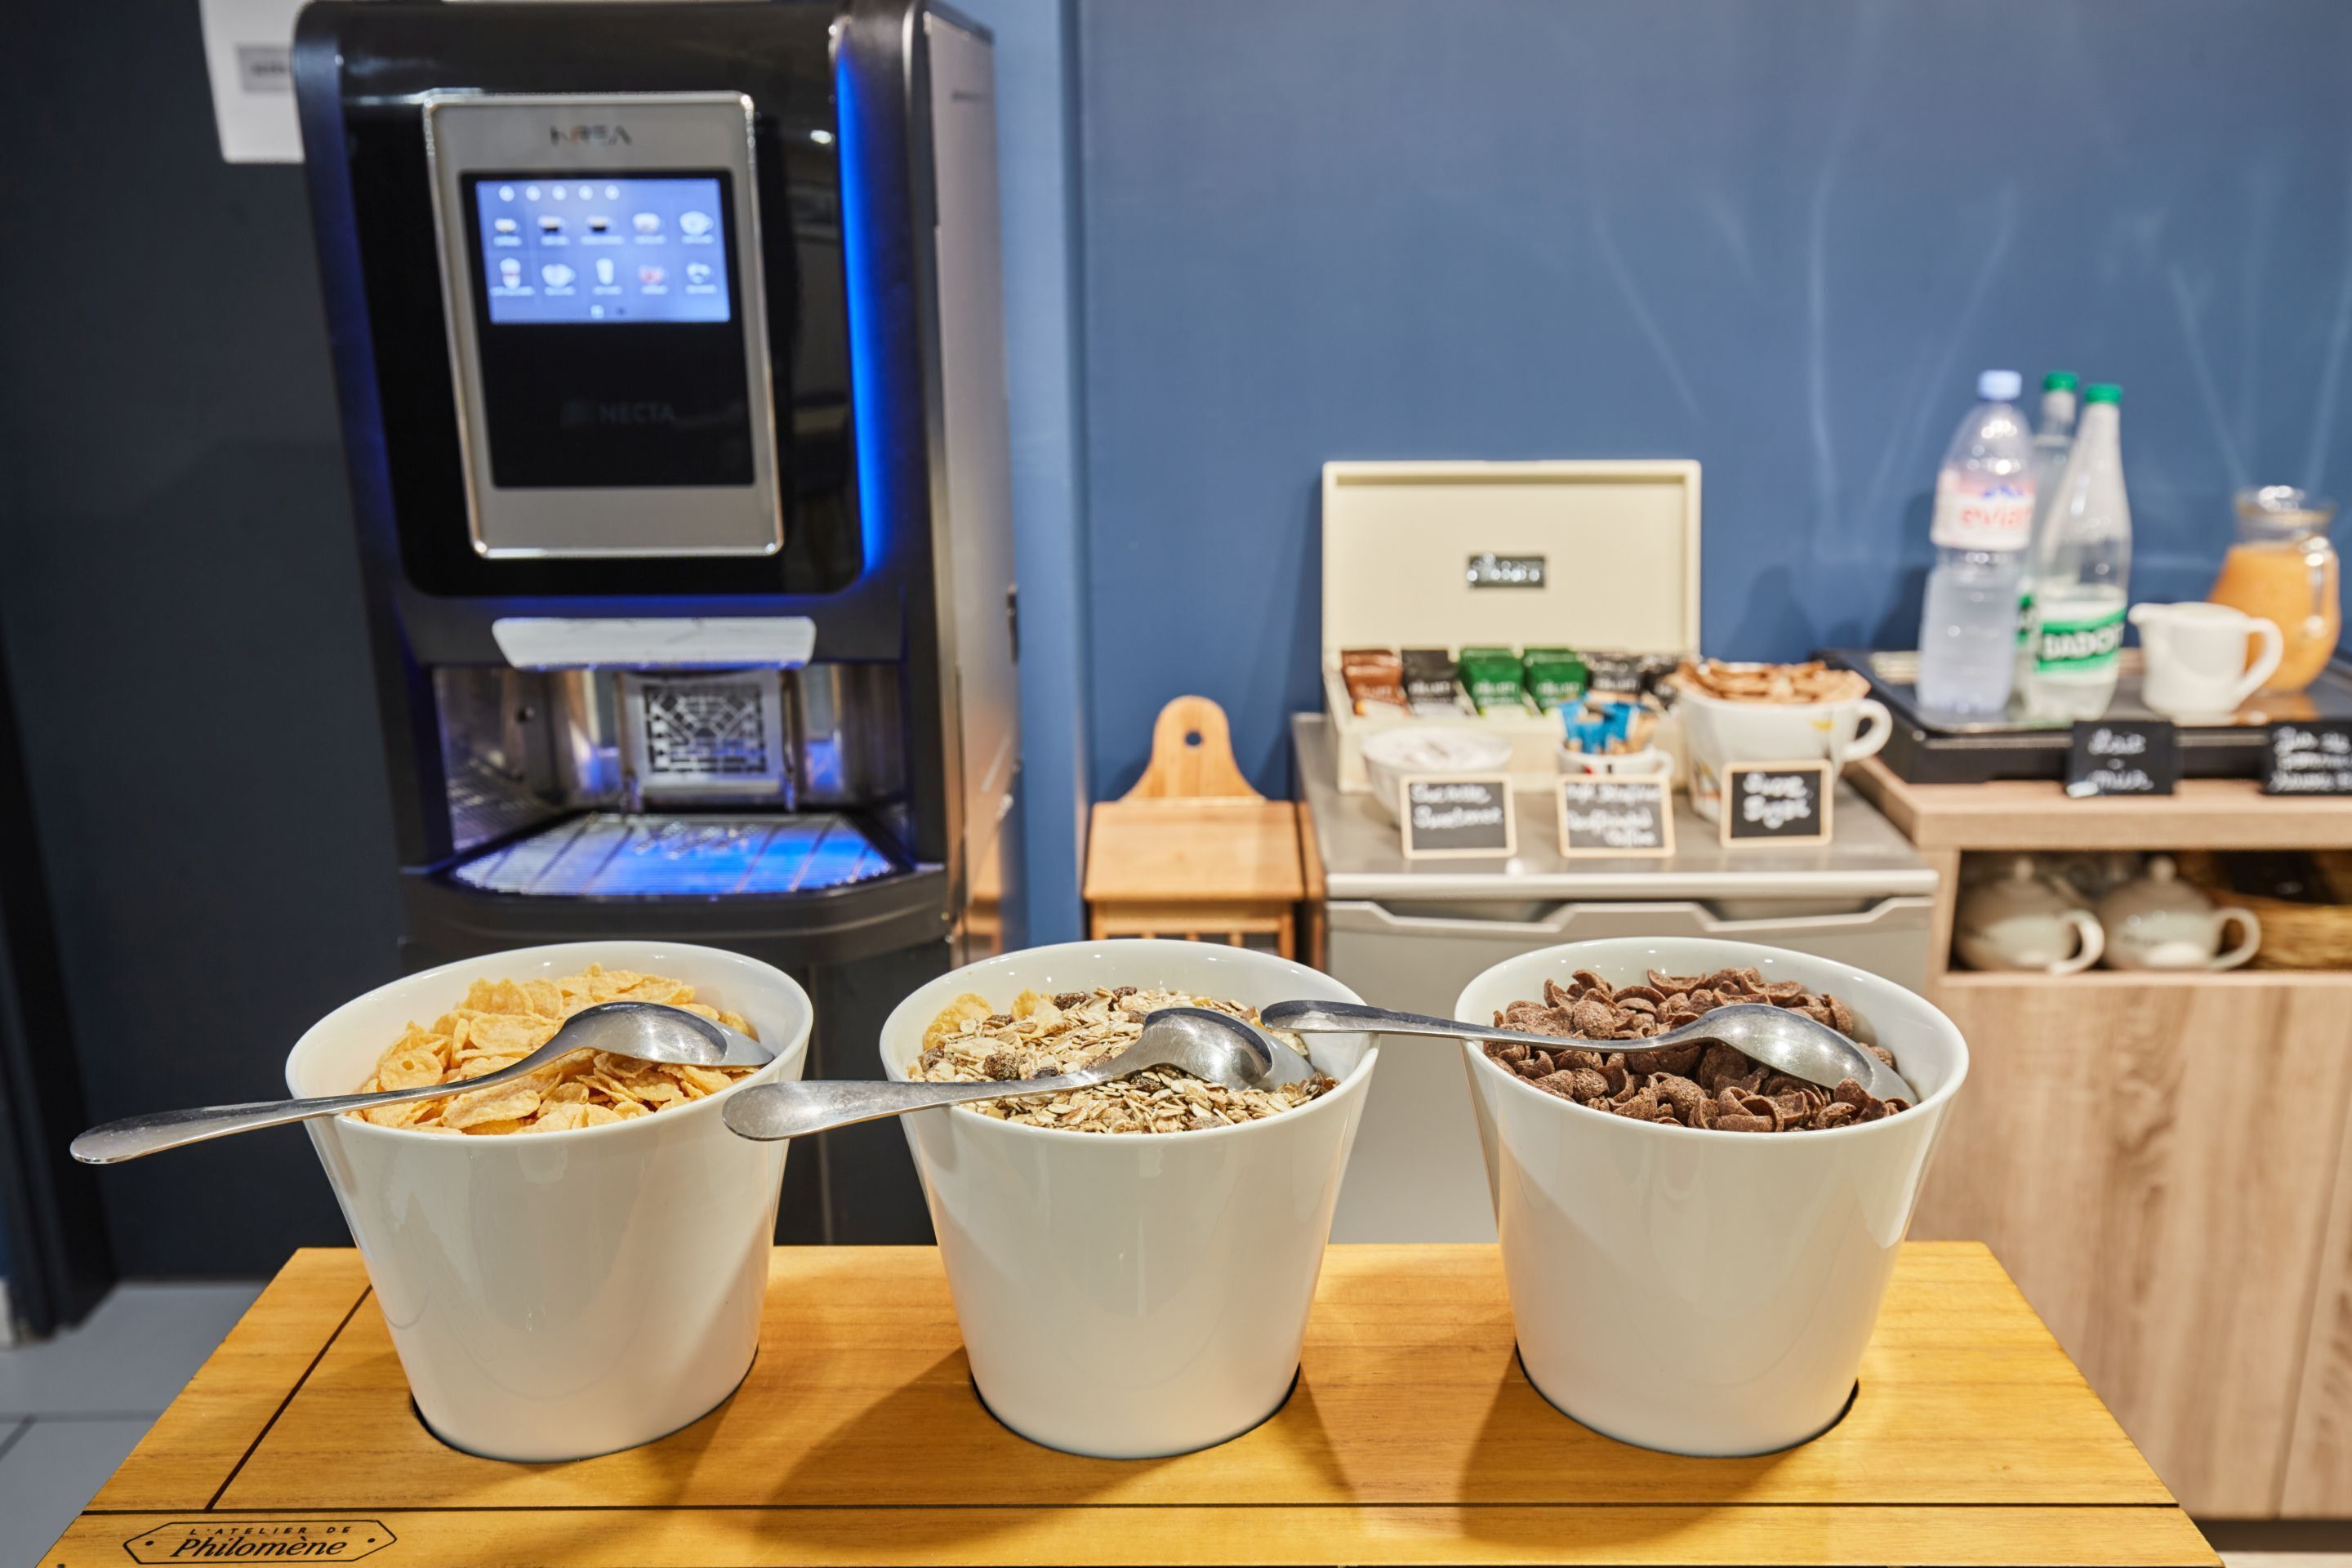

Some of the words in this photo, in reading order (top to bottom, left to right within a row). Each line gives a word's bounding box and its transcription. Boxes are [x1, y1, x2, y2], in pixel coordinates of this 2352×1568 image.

[599, 401, 675, 424] NECTA
[189, 1526, 308, 1535] L'ATELIER
[170, 1535, 347, 1557] Philomène
